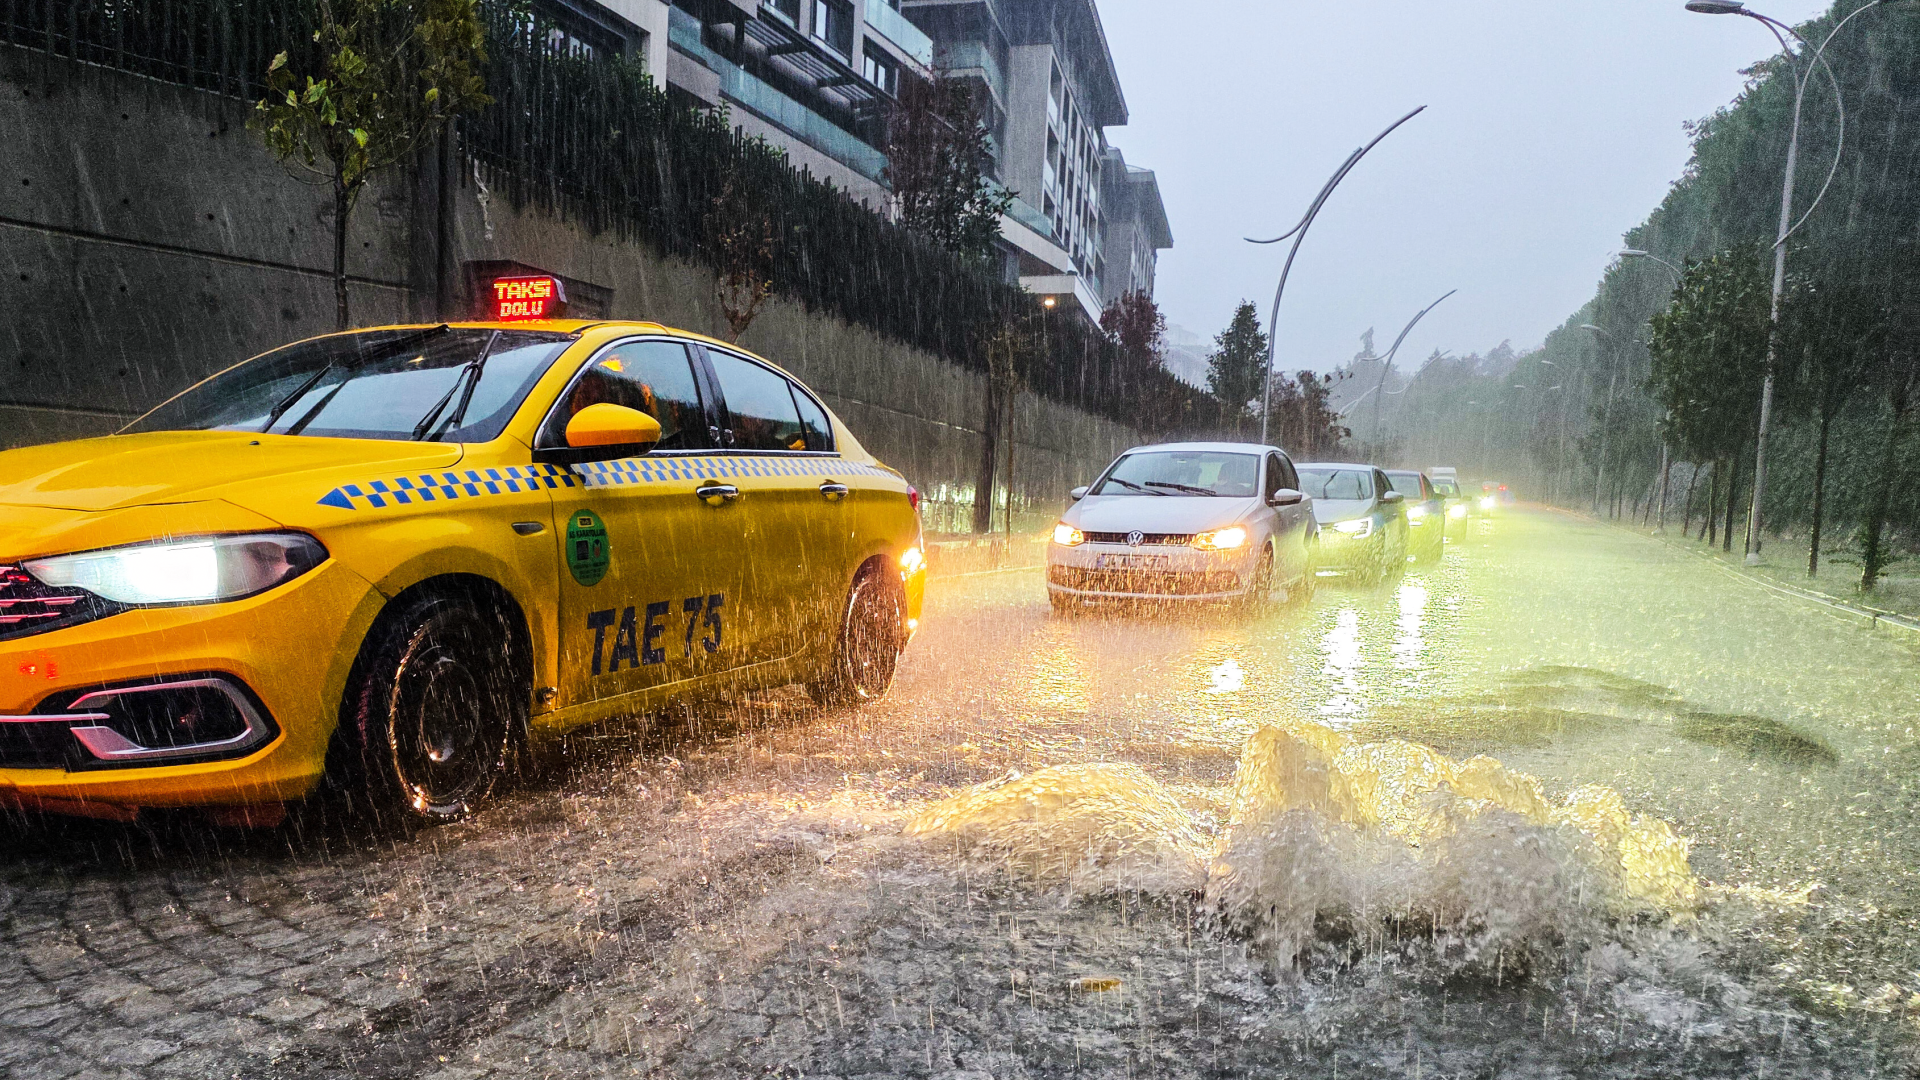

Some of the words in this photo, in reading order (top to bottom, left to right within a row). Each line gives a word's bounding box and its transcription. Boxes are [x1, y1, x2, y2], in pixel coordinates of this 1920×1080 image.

[500, 301, 543, 317] DOLU
[587, 601, 670, 676] TAE
[683, 593, 725, 658] 75
